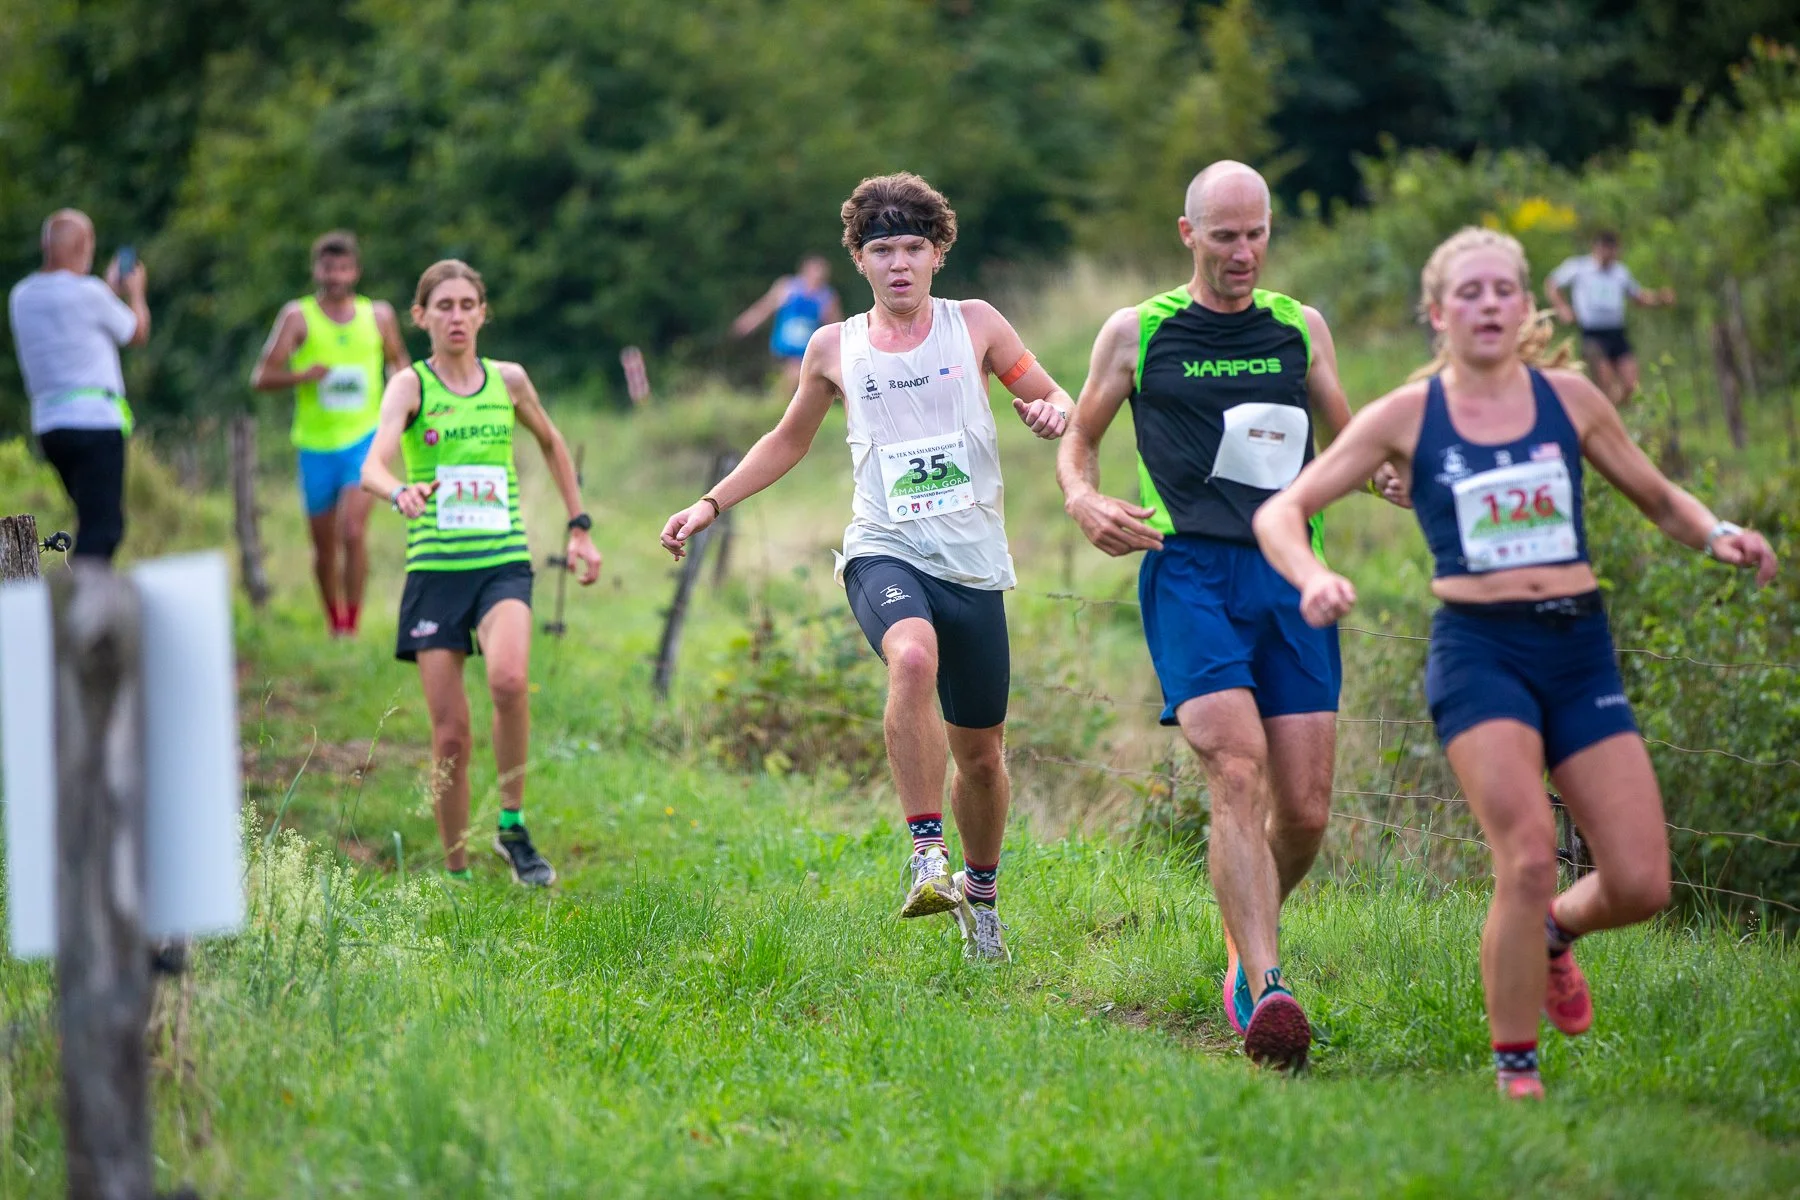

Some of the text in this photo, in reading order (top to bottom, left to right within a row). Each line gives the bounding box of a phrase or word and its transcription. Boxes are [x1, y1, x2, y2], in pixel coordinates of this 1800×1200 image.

[1182, 358, 1282, 377] KARPOS
[897, 376, 929, 389] BANDIT
[909, 454, 947, 484] 35
[454, 481, 496, 501] 112
[942, 476, 969, 488] GORA
[911, 491, 935, 500] TOWNSEND
[1482, 483, 1555, 524] 126
